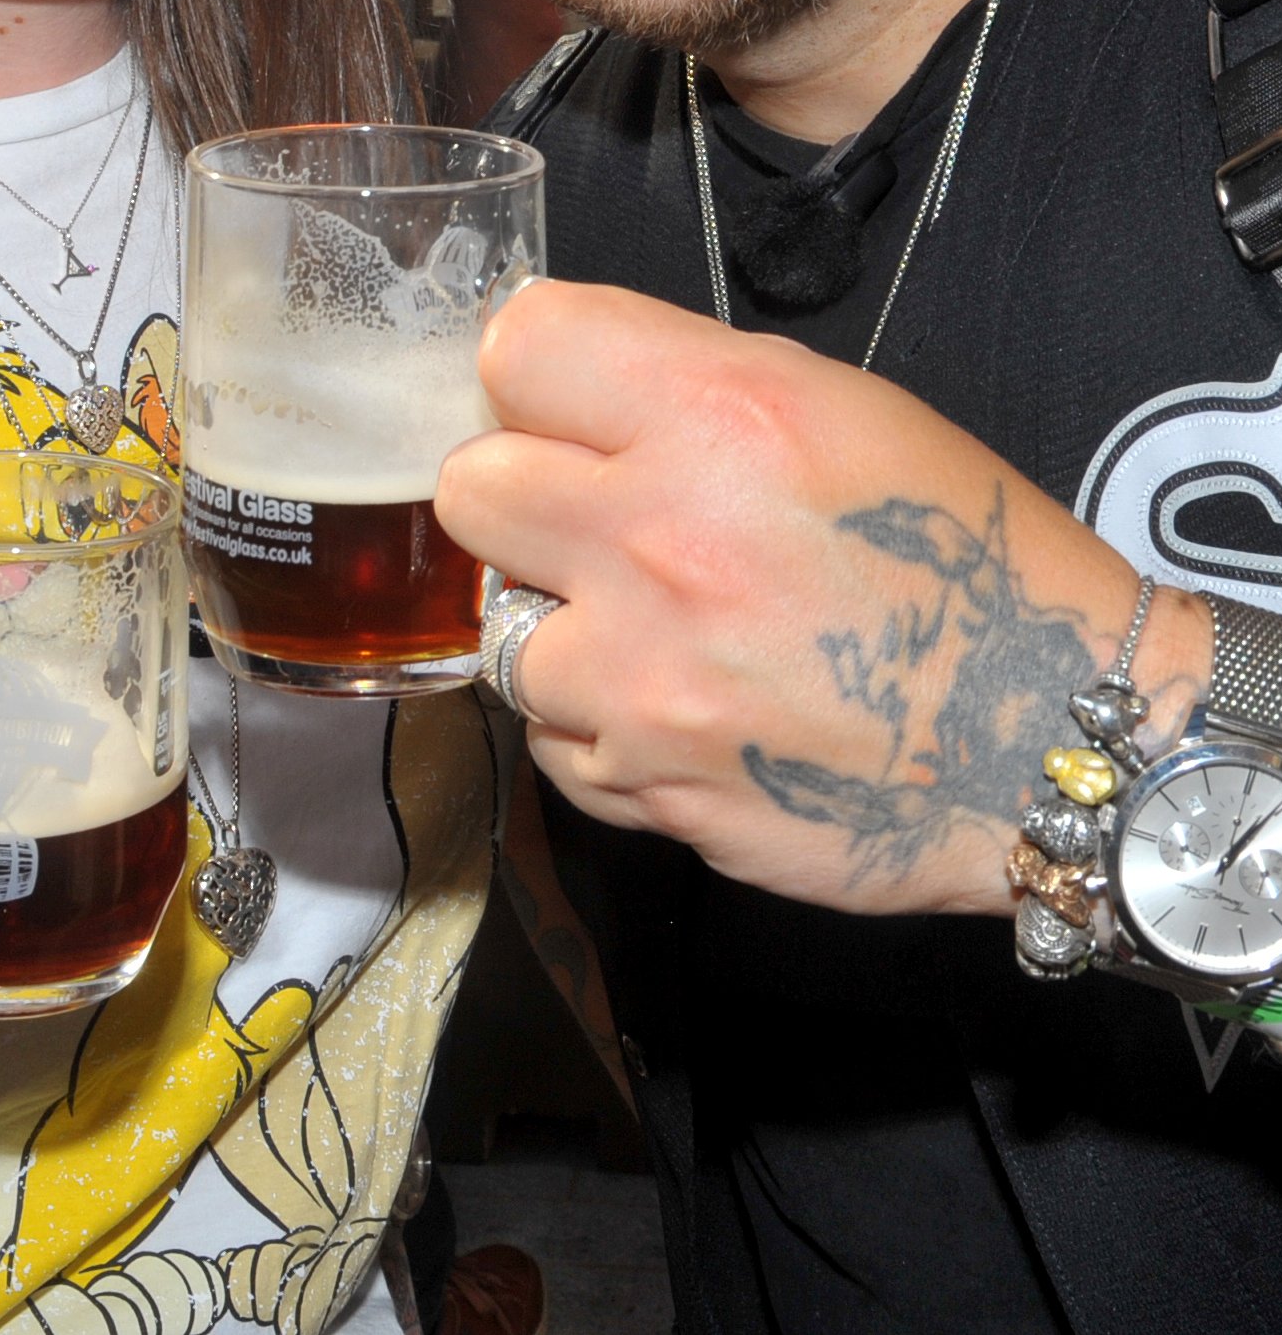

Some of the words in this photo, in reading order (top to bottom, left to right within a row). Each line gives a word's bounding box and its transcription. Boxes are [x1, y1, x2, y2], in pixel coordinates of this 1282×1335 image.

[184, 468, 233, 513] estival
[238, 487, 314, 525] Glass
[227, 516, 241, 532] for
[242, 521, 254, 535] all
[255, 526, 313, 543] occasions
